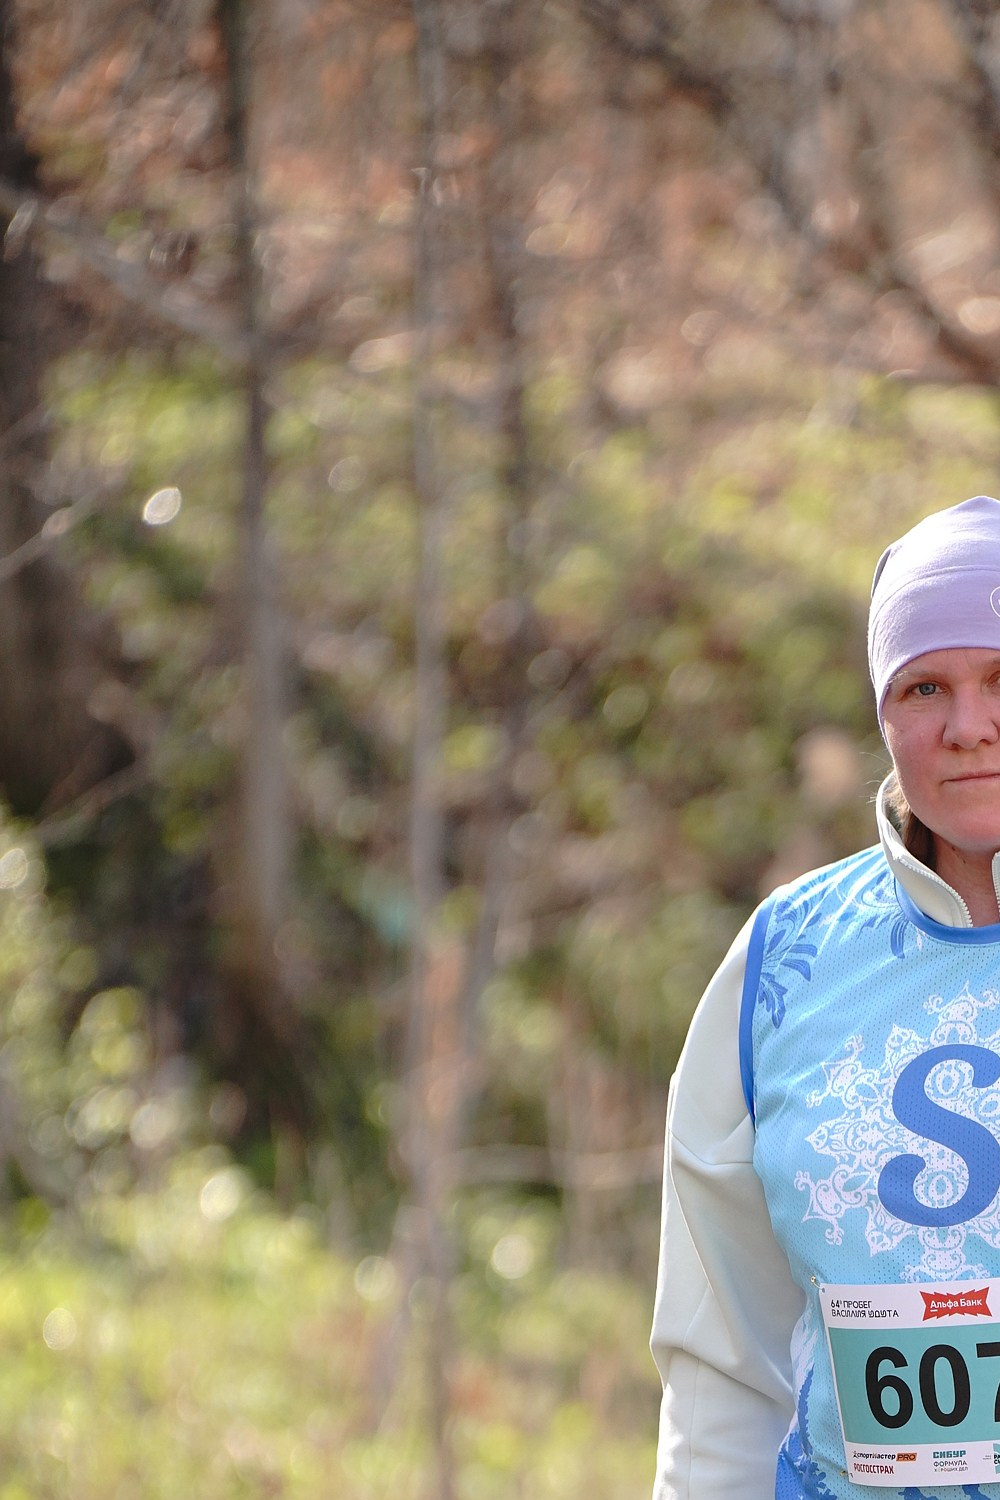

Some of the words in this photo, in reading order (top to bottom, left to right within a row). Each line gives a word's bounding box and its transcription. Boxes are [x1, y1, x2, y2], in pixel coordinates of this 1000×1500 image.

[843, 1300, 872, 1309] ПРОБЕГ
[930, 1299, 959, 1311] Альфа
[960, 1298, 982, 1307] Банк
[932, 1450, 967, 1459] СИБУР
[933, 1459, 968, 1467] ФОРМУЛА
[853, 1463, 895, 1474] РОСГОССТРАХ
